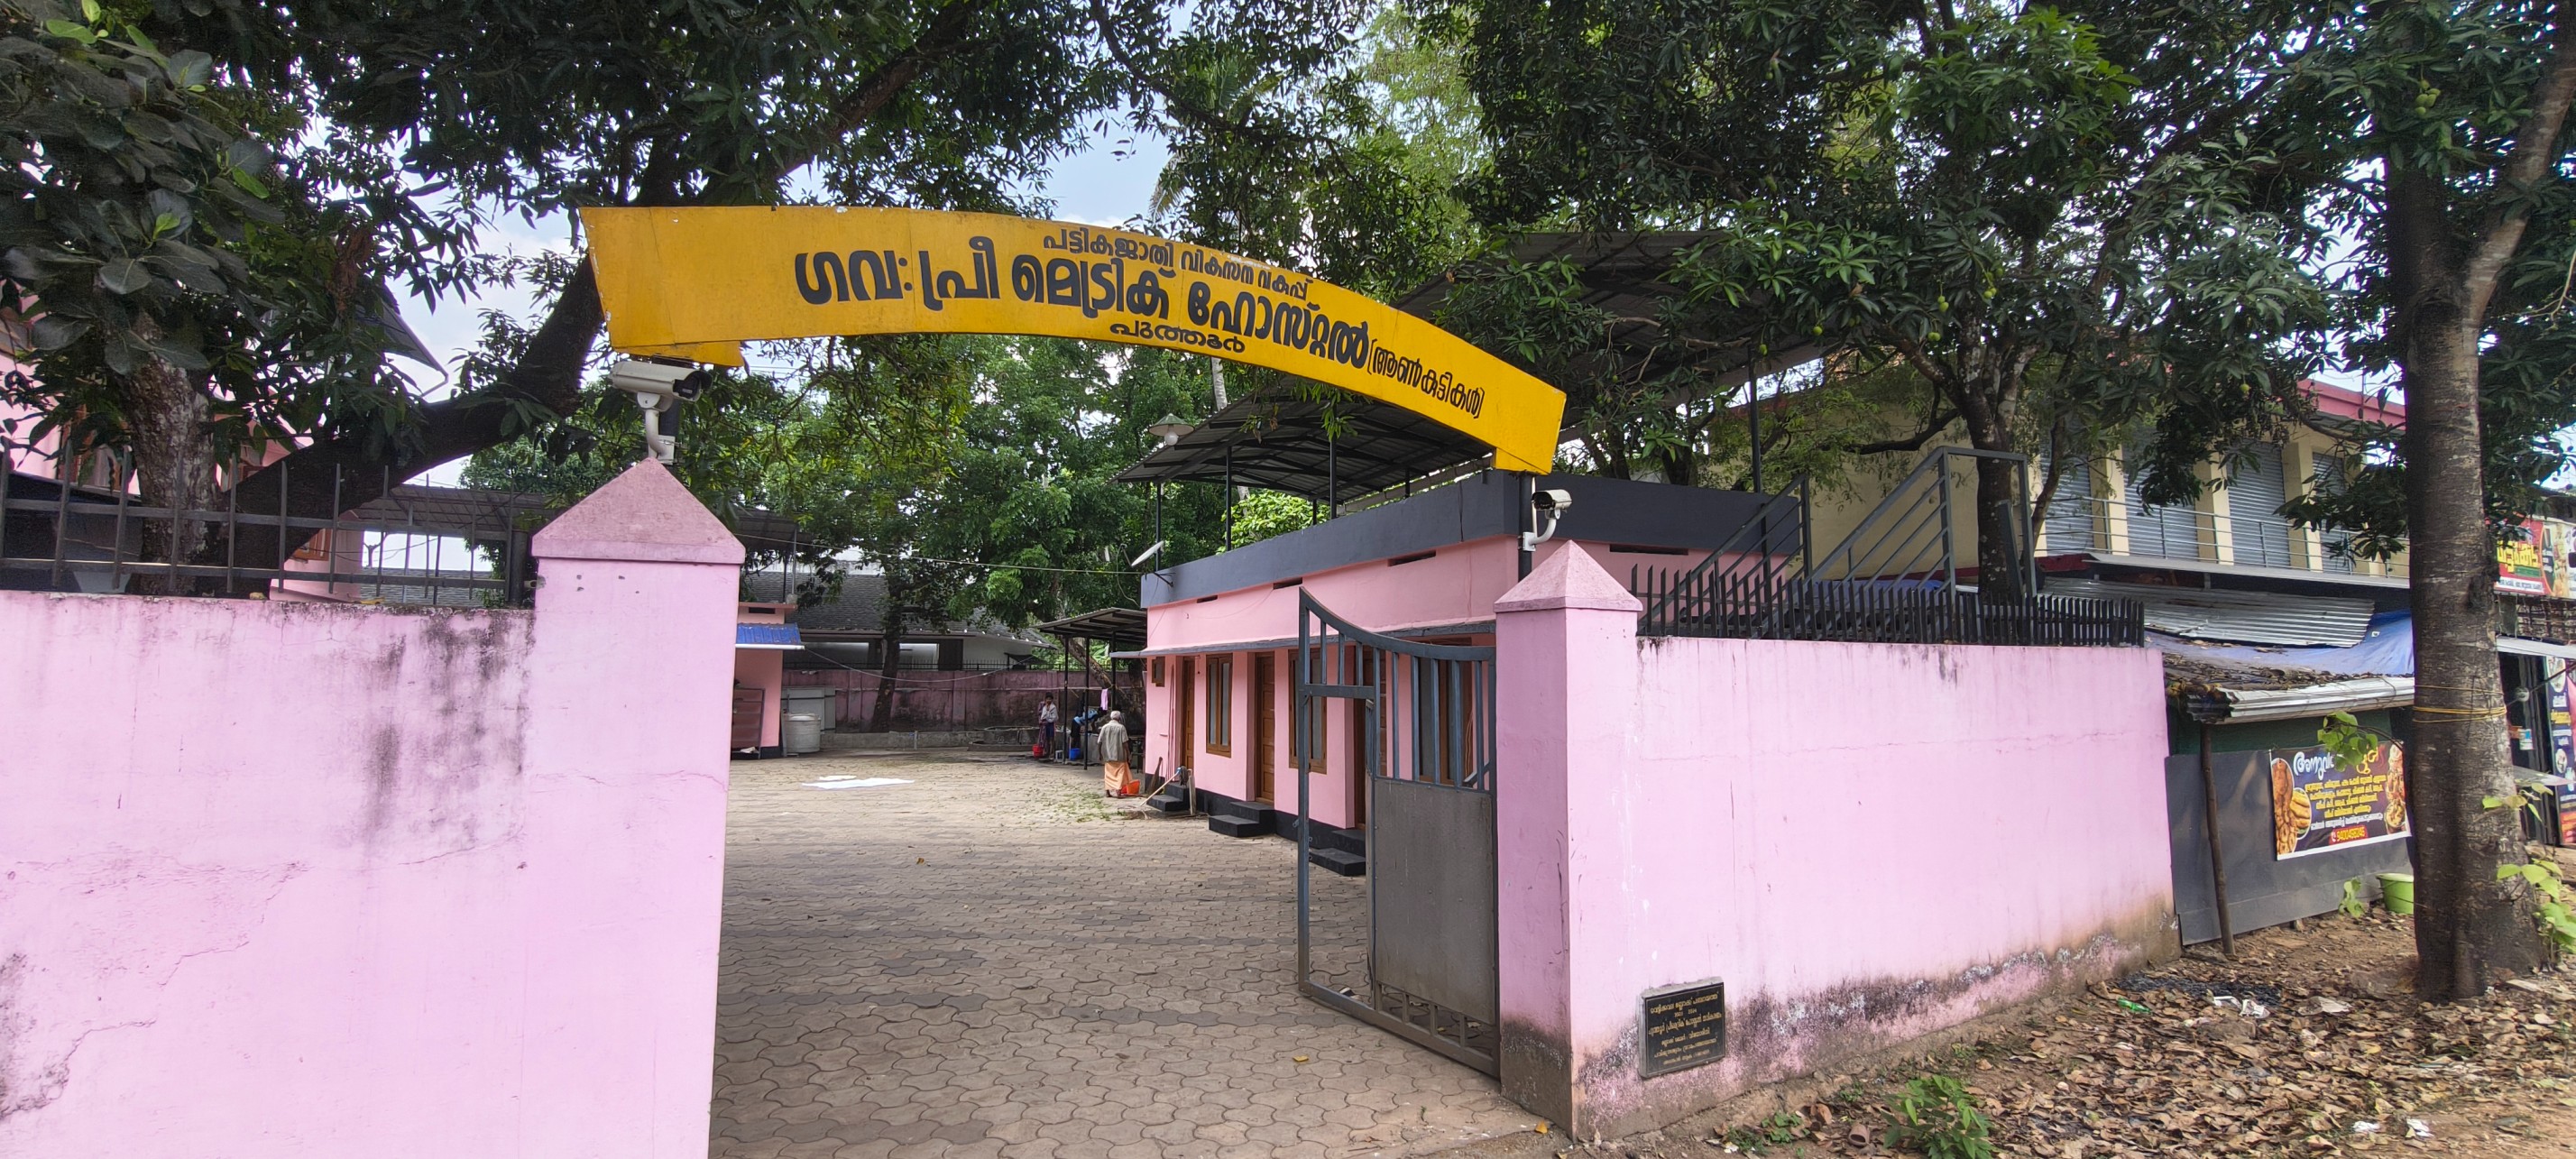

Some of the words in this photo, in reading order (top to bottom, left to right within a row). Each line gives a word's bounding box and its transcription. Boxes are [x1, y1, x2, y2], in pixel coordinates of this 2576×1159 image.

[1044, 227, 1174, 268] പട്ടികജാതി
[1181, 249, 1254, 285] വികസന
[1257, 270, 1314, 301] വകുപ്പ്
[1011, 253, 1176, 319] മെട്രിക്
[1188, 281, 1370, 370] ഹോസ്റ്റൽ
[1109, 320, 1246, 354] പുത്തൂർ
